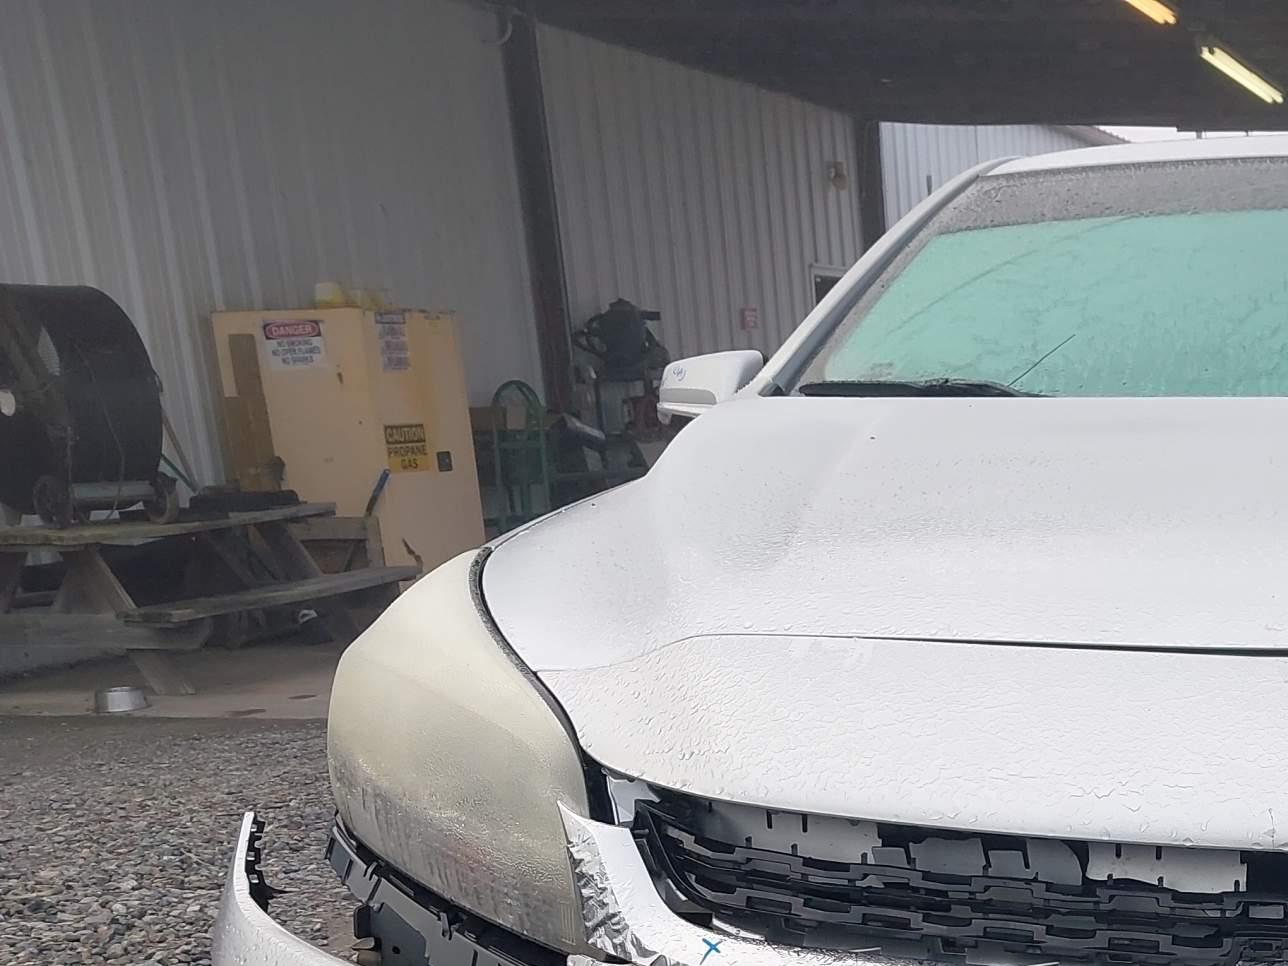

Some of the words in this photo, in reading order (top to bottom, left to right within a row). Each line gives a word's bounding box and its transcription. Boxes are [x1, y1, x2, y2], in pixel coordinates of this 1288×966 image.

[271, 324, 313, 336] DANGER
[386, 426, 425, 442] CAUTION
[387, 445, 428, 458] PROPANE
[401, 458, 419, 470] GAS
